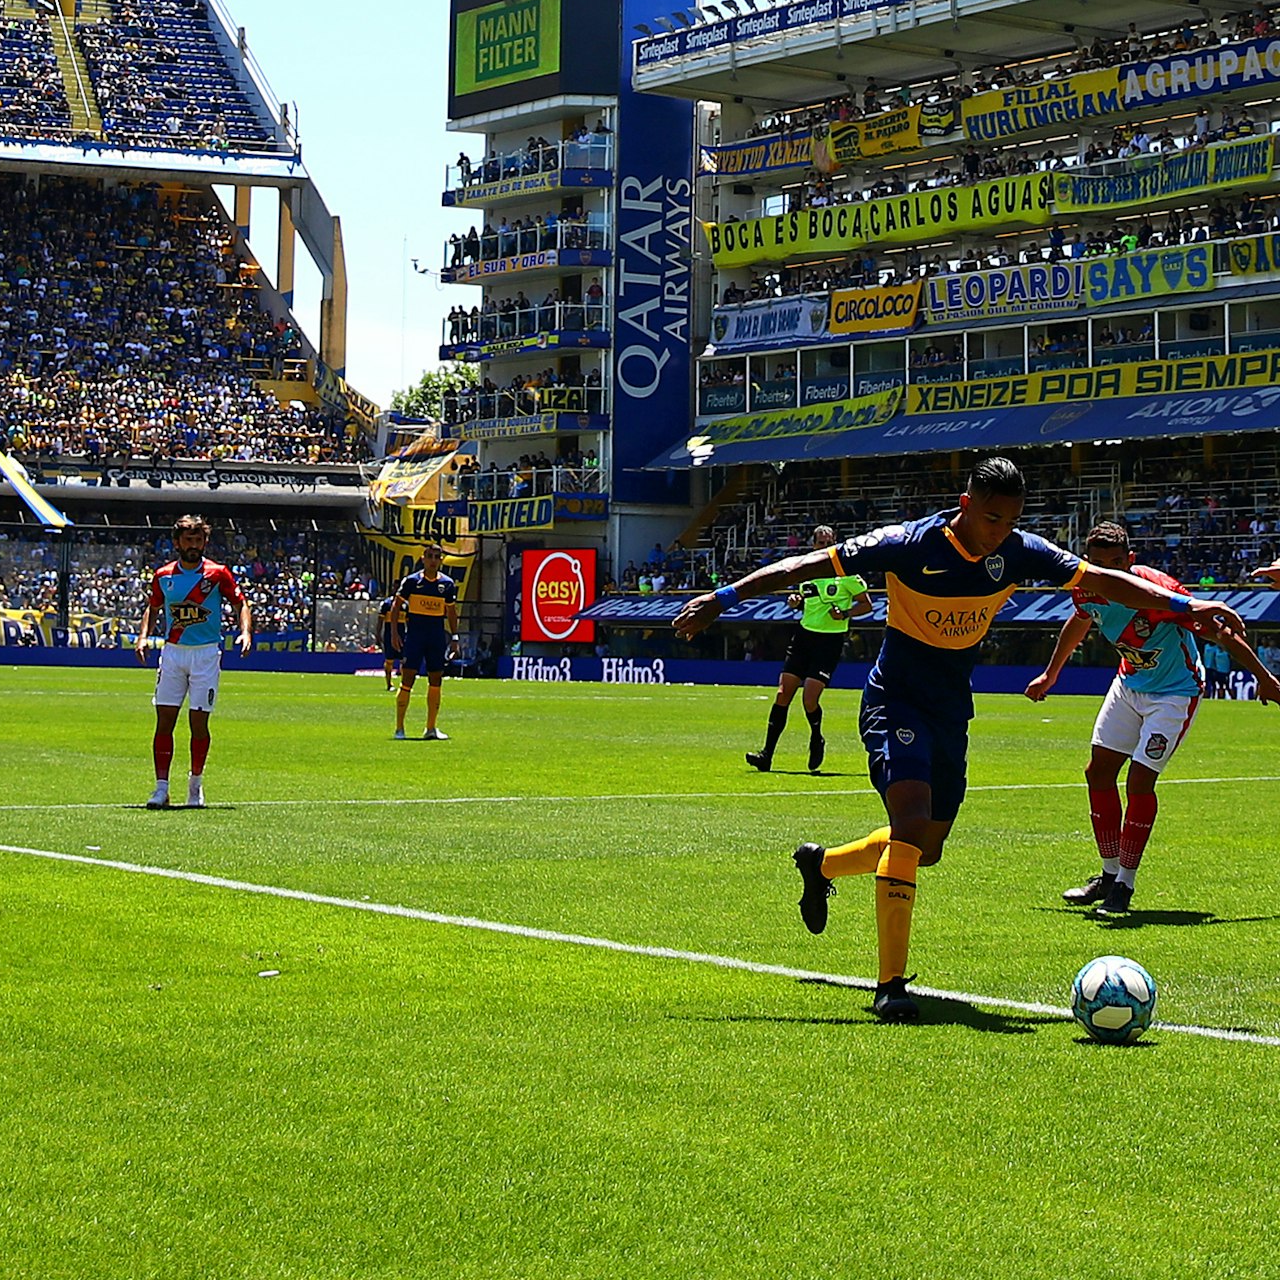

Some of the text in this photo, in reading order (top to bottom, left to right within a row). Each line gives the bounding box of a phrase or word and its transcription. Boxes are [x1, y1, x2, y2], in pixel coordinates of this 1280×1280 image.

[736, 12, 780, 37] Sinteplast
[787, 0, 832, 24] Sinteplast
[478, 6, 537, 45] MANN
[686, 24, 727, 50] Sinteplast
[478, 33, 537, 74] FILTER
[639, 37, 679, 61] Sinteplast
[1002, 81, 1077, 108] FILIAL
[965, 86, 1124, 142] HURLINGHAM
[711, 217, 765, 255] BOCA
[774, 212, 799, 245] ES
[870, 194, 958, 237] CARLOS
[483, 259, 506, 273] SUR
[510, 257, 519, 269] Y
[521, 253, 545, 267] ORO
[663, 178, 691, 344] AIRWAYS
[617, 175, 670, 399] QATAR
[928, 265, 1083, 312] LEOPARDI
[834, 293, 915, 324] CIRCOLOCO
[805, 383, 841, 400] Fibertel
[915, 379, 1029, 413] XENEIZE
[1127, 395, 1240, 420] AXION
[910, 420, 970, 435] MITAD
[123, 468, 203, 485] GATORADE
[470, 497, 552, 532] BANFIELD
[536, 581, 579, 605] easy
[925, 606, 989, 628] QATAR
[512, 657, 571, 682] Hidro3
[601, 658, 665, 683] Hidro3
